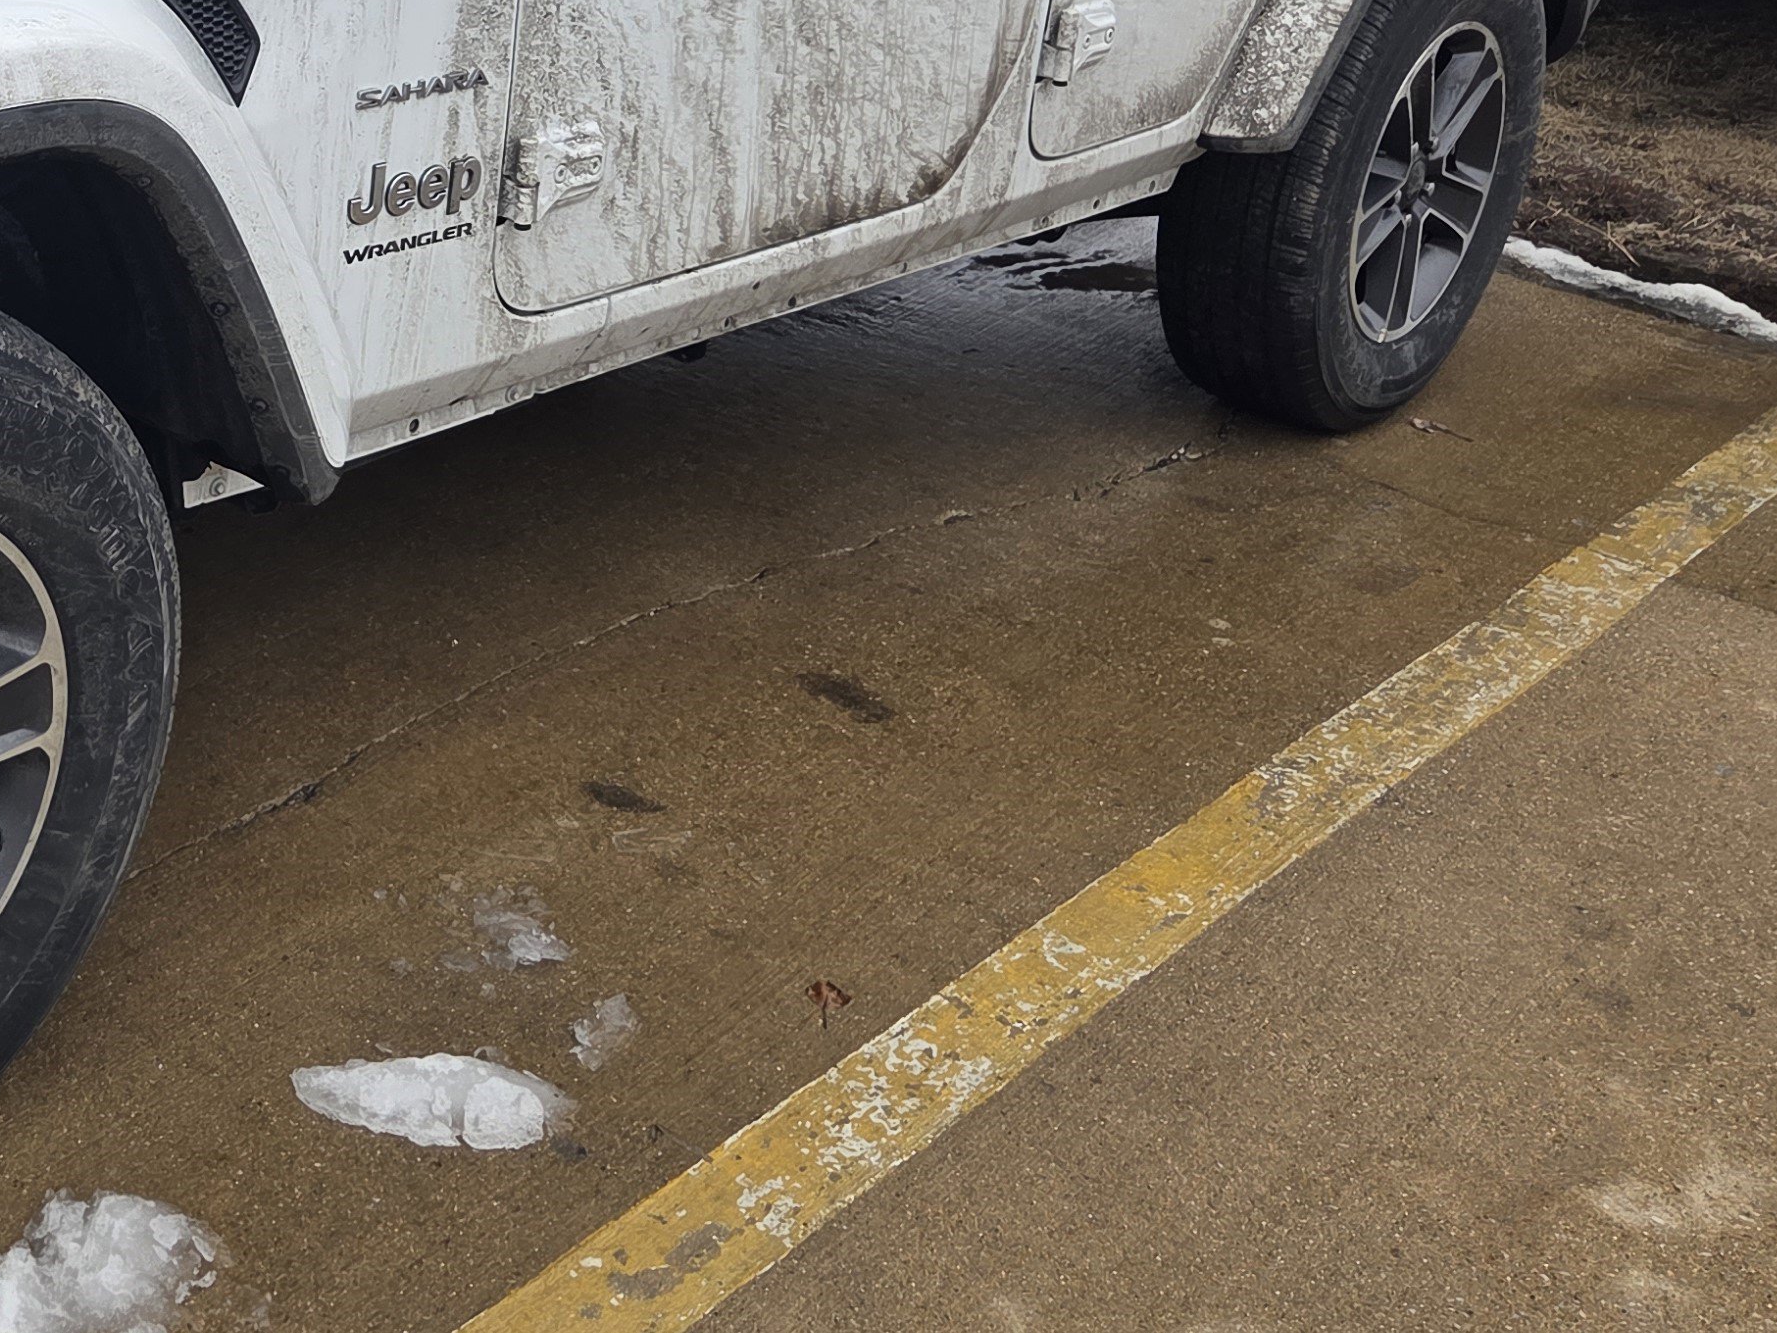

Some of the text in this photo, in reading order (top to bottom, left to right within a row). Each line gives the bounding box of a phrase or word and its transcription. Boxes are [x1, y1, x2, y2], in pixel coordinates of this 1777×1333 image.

[355, 69, 490, 111] SAHARA
[347, 155, 482, 225] Jeep
[343, 222, 473, 265] WRANGLER
